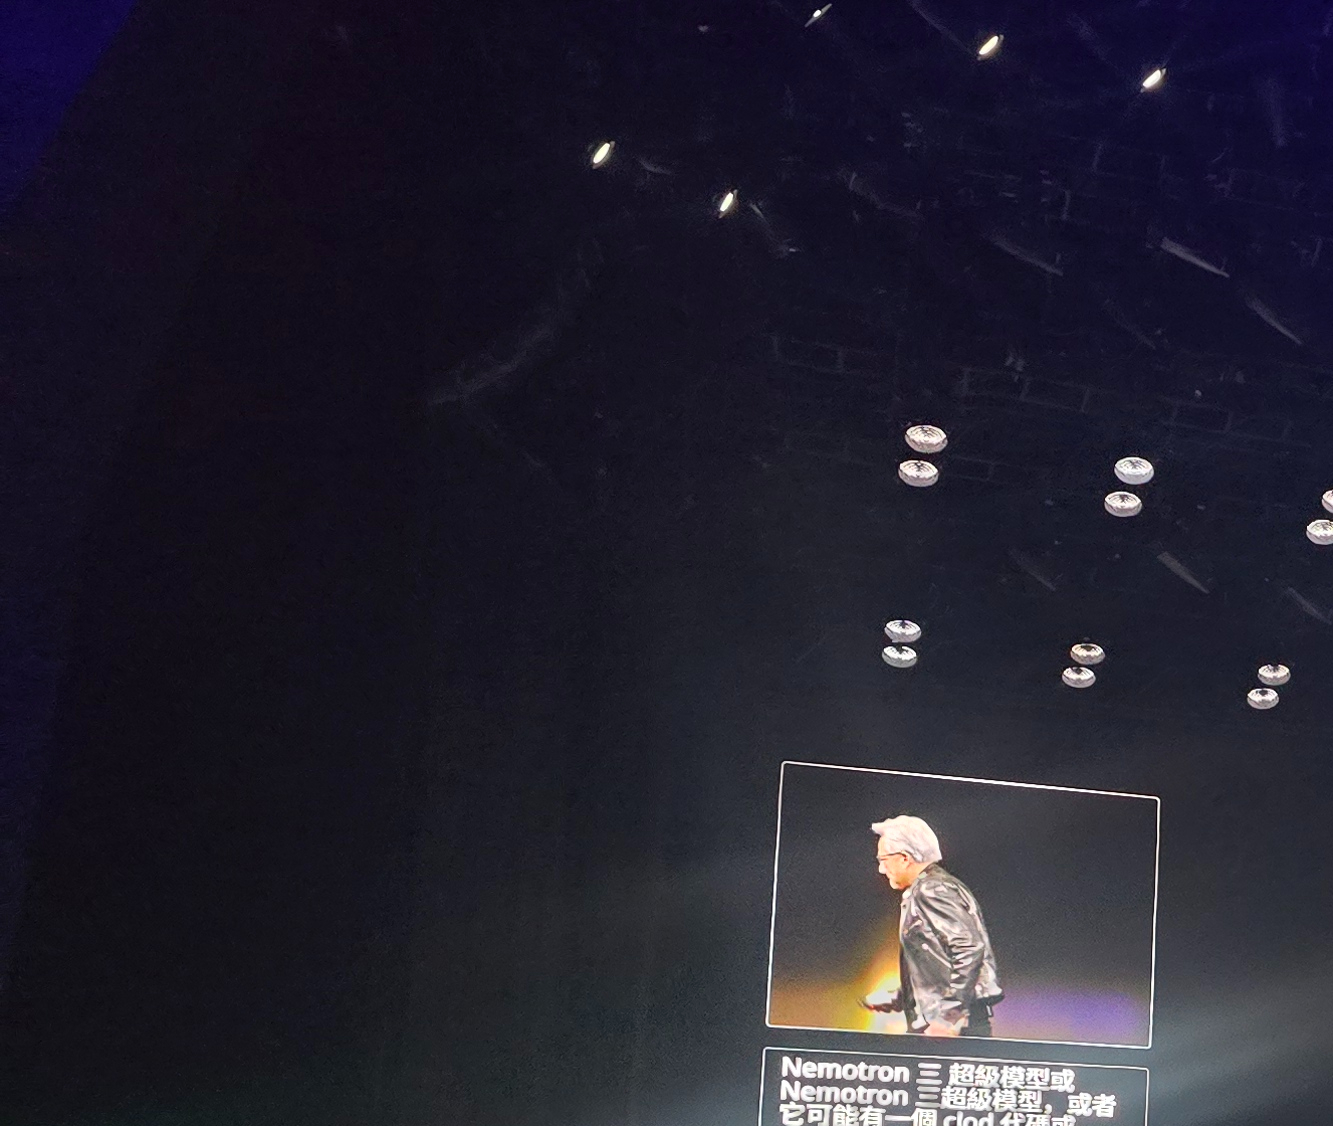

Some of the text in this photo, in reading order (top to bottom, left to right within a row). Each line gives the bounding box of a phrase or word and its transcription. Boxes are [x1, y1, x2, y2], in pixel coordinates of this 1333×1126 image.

[781, 1056, 1076, 1094] Nemotron 三 超級模型或
[779, 1079, 909, 1106] Nemotron
